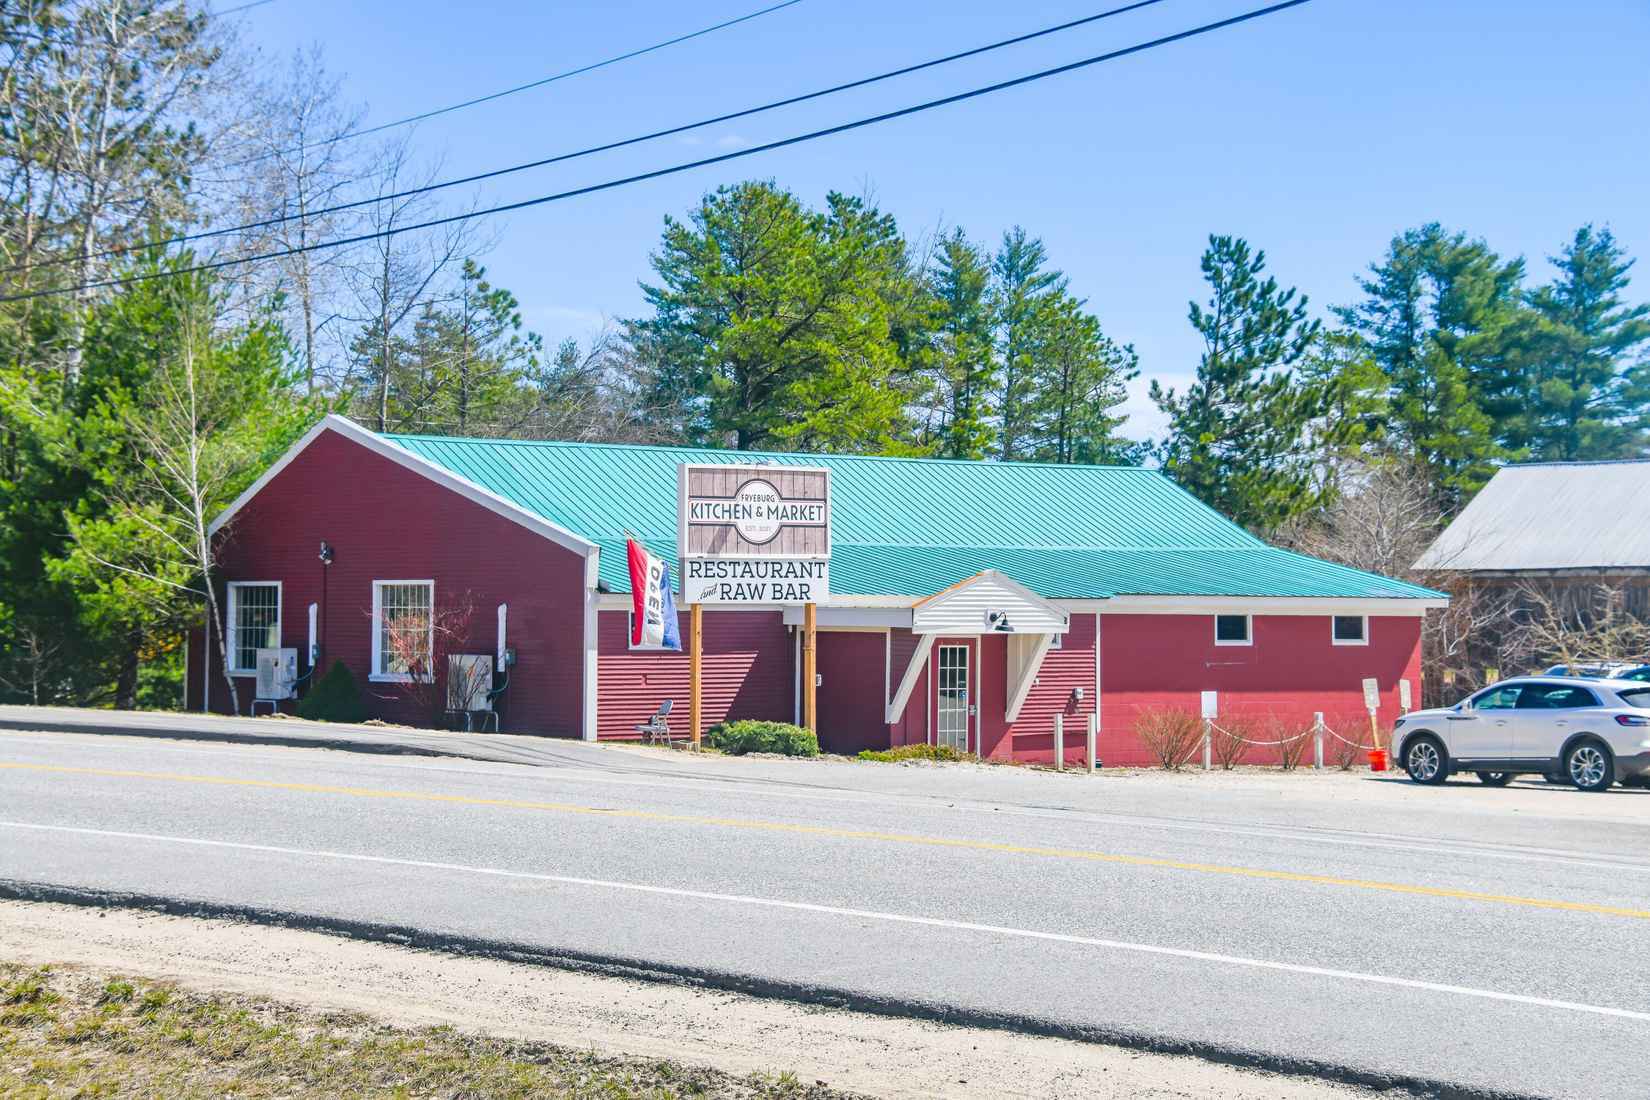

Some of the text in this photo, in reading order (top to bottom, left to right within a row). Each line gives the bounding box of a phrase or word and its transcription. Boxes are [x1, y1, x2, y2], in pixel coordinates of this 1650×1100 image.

[741, 494, 776, 503] FRYEBURG
[690, 502, 823, 521] KITCHEN & MARKET
[689, 560, 826, 579] RESTAURANT
[697, 583, 811, 601] and RAW BAR
